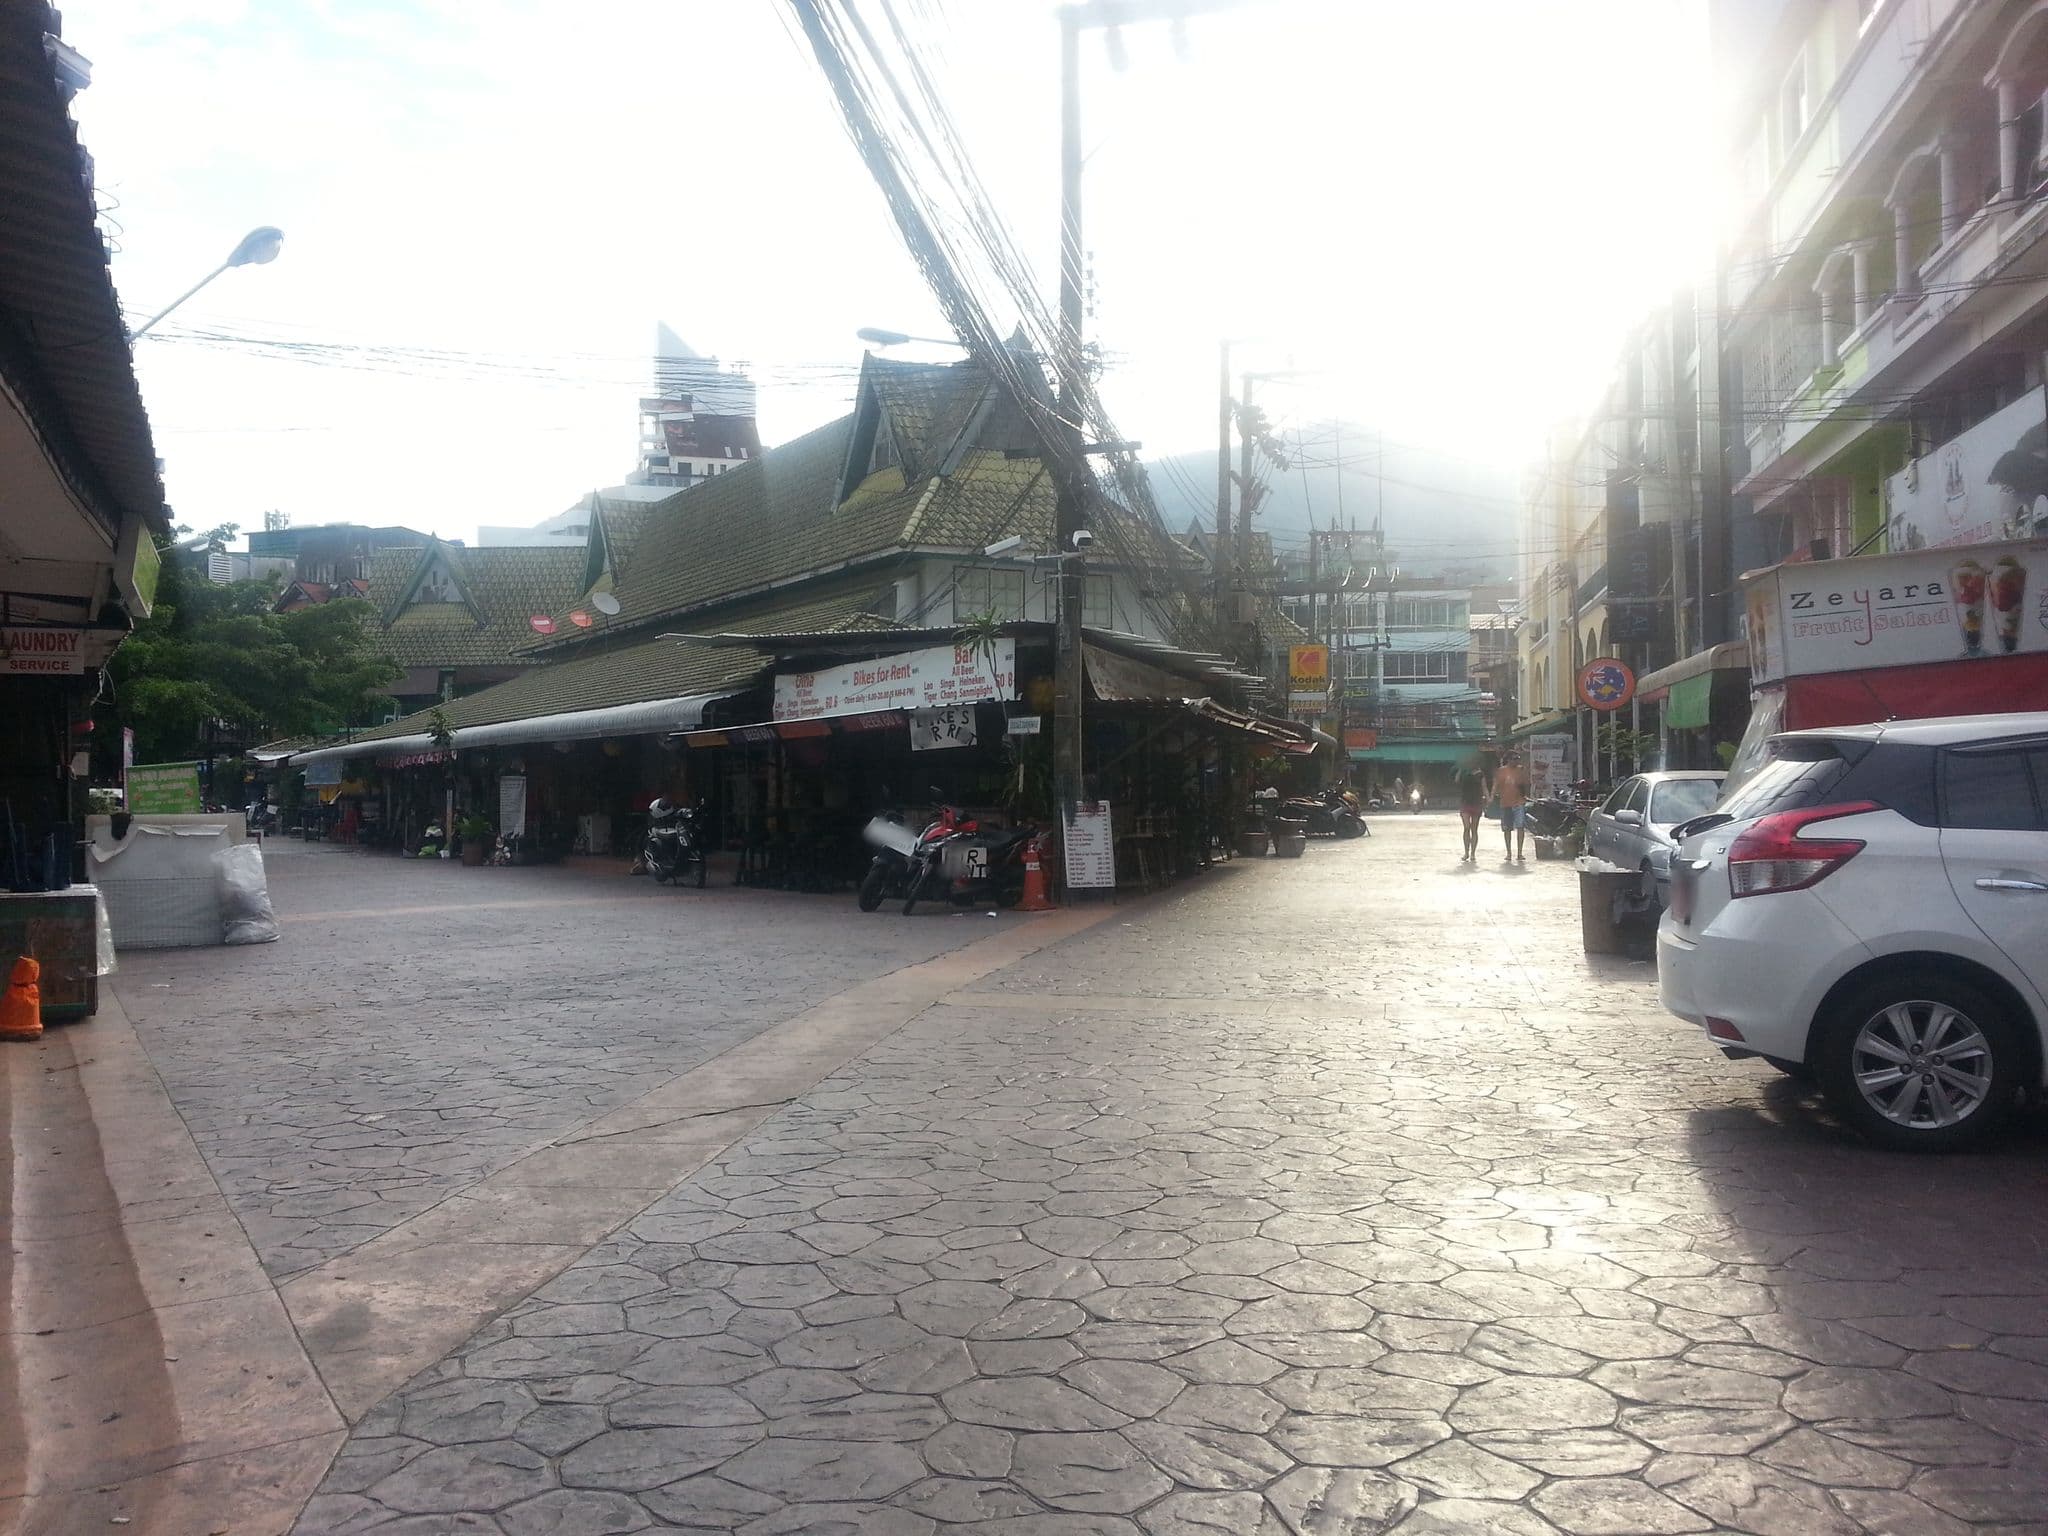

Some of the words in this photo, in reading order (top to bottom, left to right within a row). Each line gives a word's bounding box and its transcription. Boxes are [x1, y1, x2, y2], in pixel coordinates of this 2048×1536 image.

[1791, 582, 1944, 646] Zeyara
[1793, 616, 1865, 637] Fruit
[1872, 608, 1950, 630] Salad
[955, 645, 973, 664] Bar
[10, 660, 70, 671] SERVICE
[853, 670, 875, 686] Bikes
[877, 667, 890, 682] for
[891, 664, 912, 680] Rent
[961, 665, 975, 675] Beer
[1290, 675, 1326, 684] Kodak
